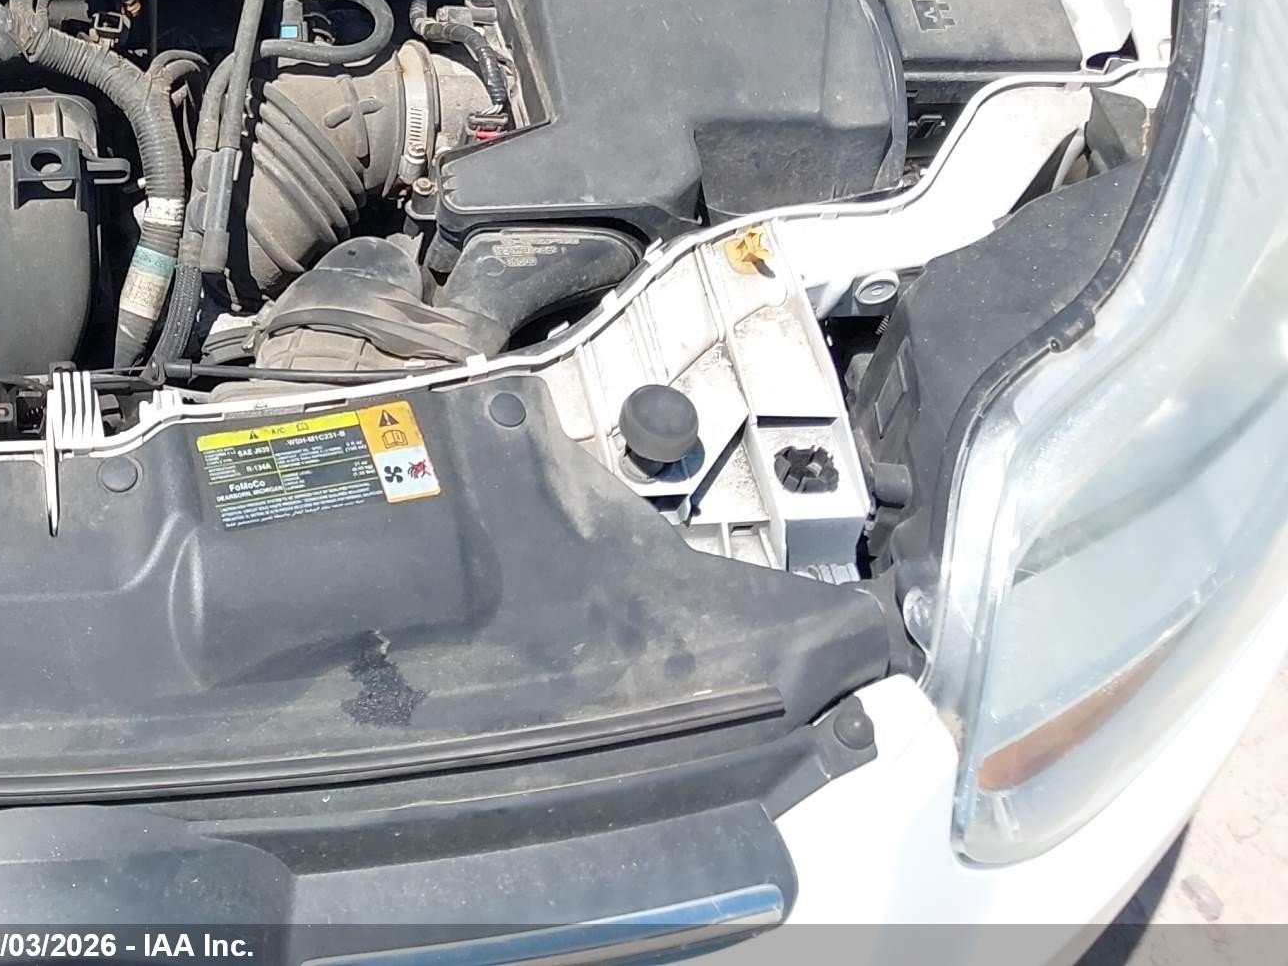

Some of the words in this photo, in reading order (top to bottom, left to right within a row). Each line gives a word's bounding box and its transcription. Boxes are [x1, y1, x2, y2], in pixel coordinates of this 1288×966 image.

[271, 427, 286, 435] A/C
[237, 448, 253, 458] SAE
[245, 463, 272, 472] R-134A
[229, 480, 266, 492] FoMoCo
[253, 485, 283, 495] MICHIGAN
